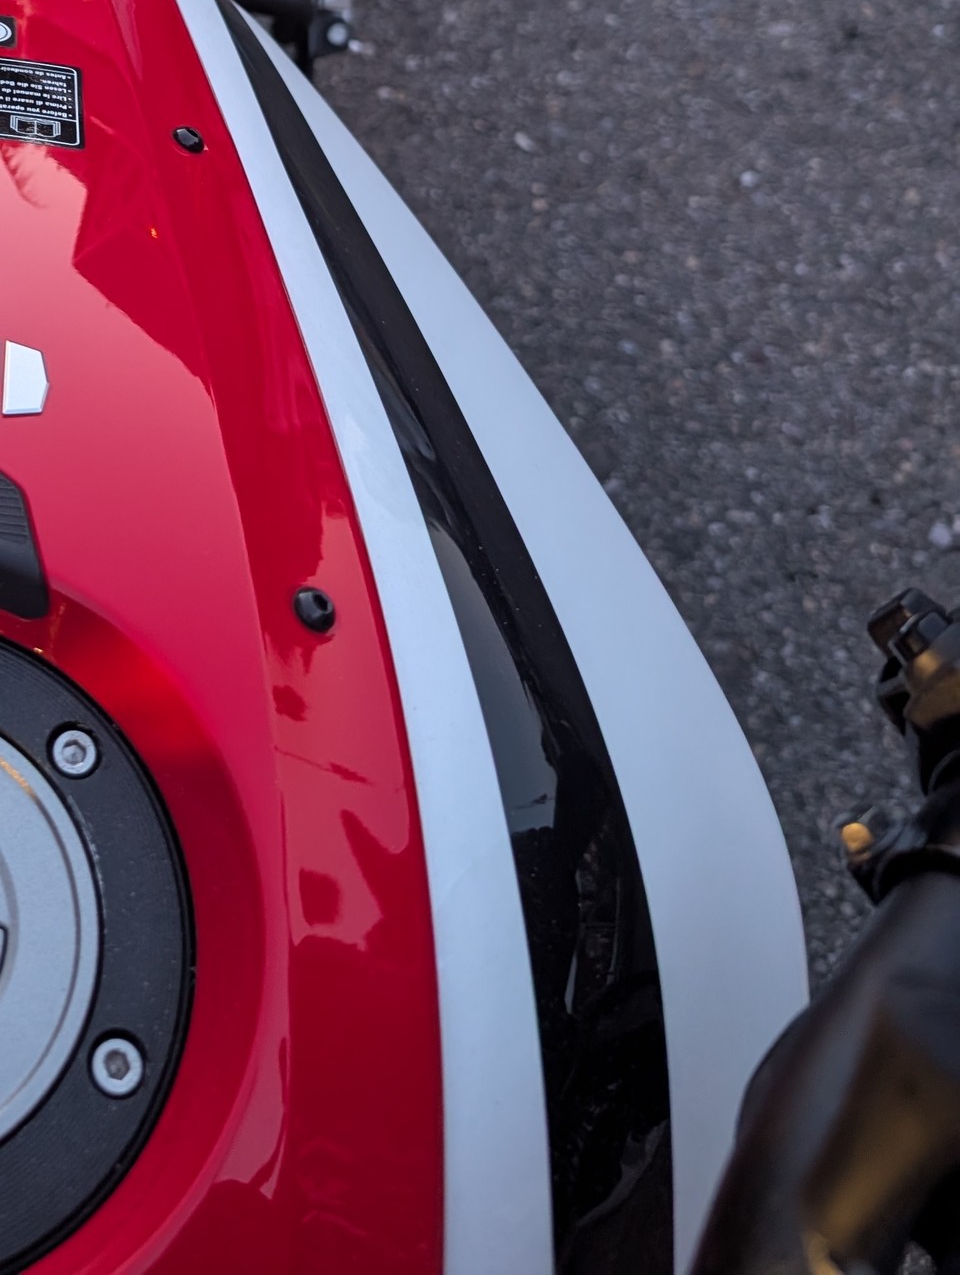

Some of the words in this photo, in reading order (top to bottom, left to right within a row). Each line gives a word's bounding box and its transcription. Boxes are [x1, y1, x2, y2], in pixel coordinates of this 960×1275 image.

[0, 66, 33, 75] conducir
[46, 72, 67, 80] Antes
[30, 83, 43, 91] Sie
[44, 85, 67, 93] Lesen
[45, 101, 67, 110] Prima
[42, 109, 67, 118] Before
